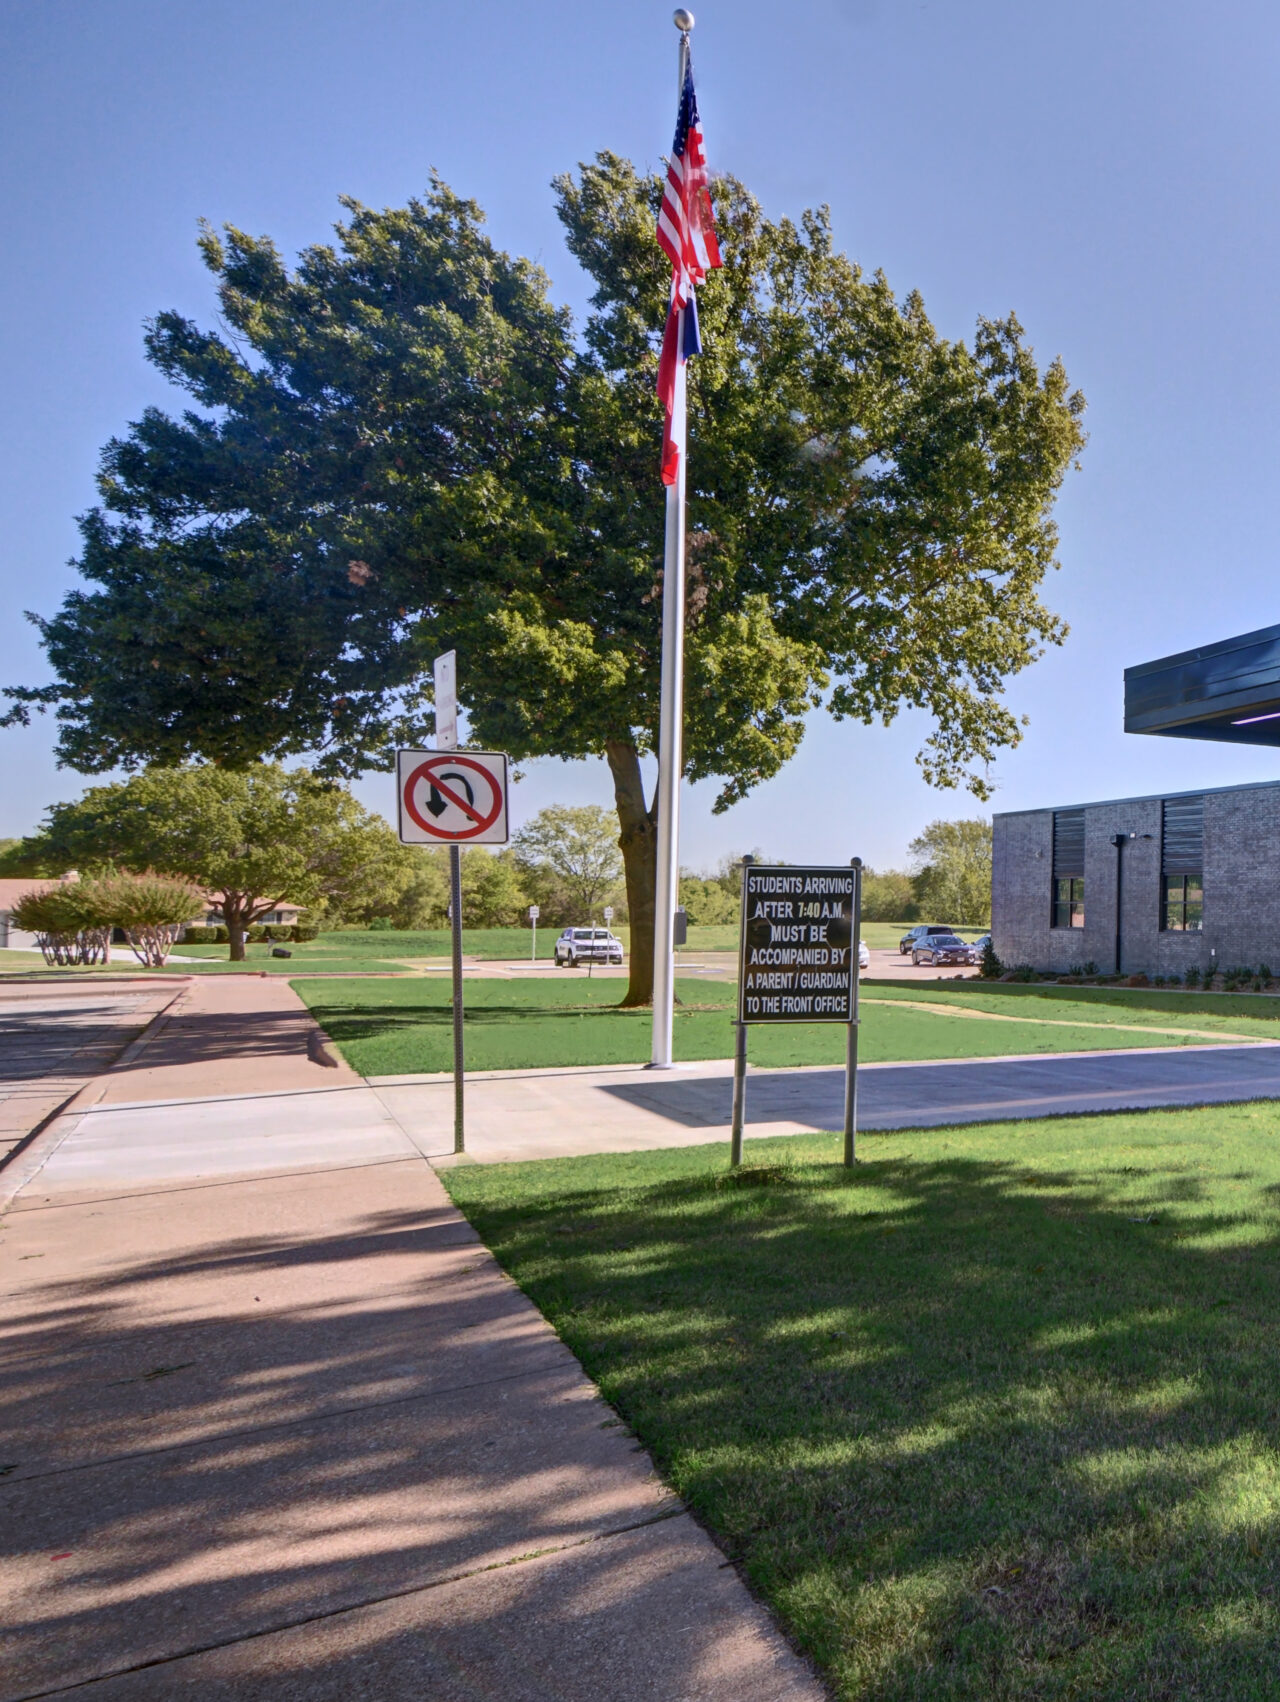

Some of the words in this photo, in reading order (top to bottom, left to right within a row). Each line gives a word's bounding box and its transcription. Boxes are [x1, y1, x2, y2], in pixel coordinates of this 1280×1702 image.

[749, 876, 802, 893] STUDENTS
[804, 877, 852, 894] ARRIVING
[755, 901, 793, 918] AFTER
[798, 902, 820, 918] 7:40
[821, 902, 845, 918] A.M.
[771, 925, 807, 942] MUST
[810, 925, 827, 942] BE
[751, 948, 829, 965] ACCOMPANIED
[831, 948, 846, 965] BY
[746, 973, 754, 989] A
[756, 973, 793, 989] PARENT
[800, 973, 849, 989] GUARDIAN
[746, 996, 760, 1013] TO
[761, 996, 780, 1013] THE
[782, 996, 813, 1013] FRONT
[814, 996, 847, 1013] OFFICE
